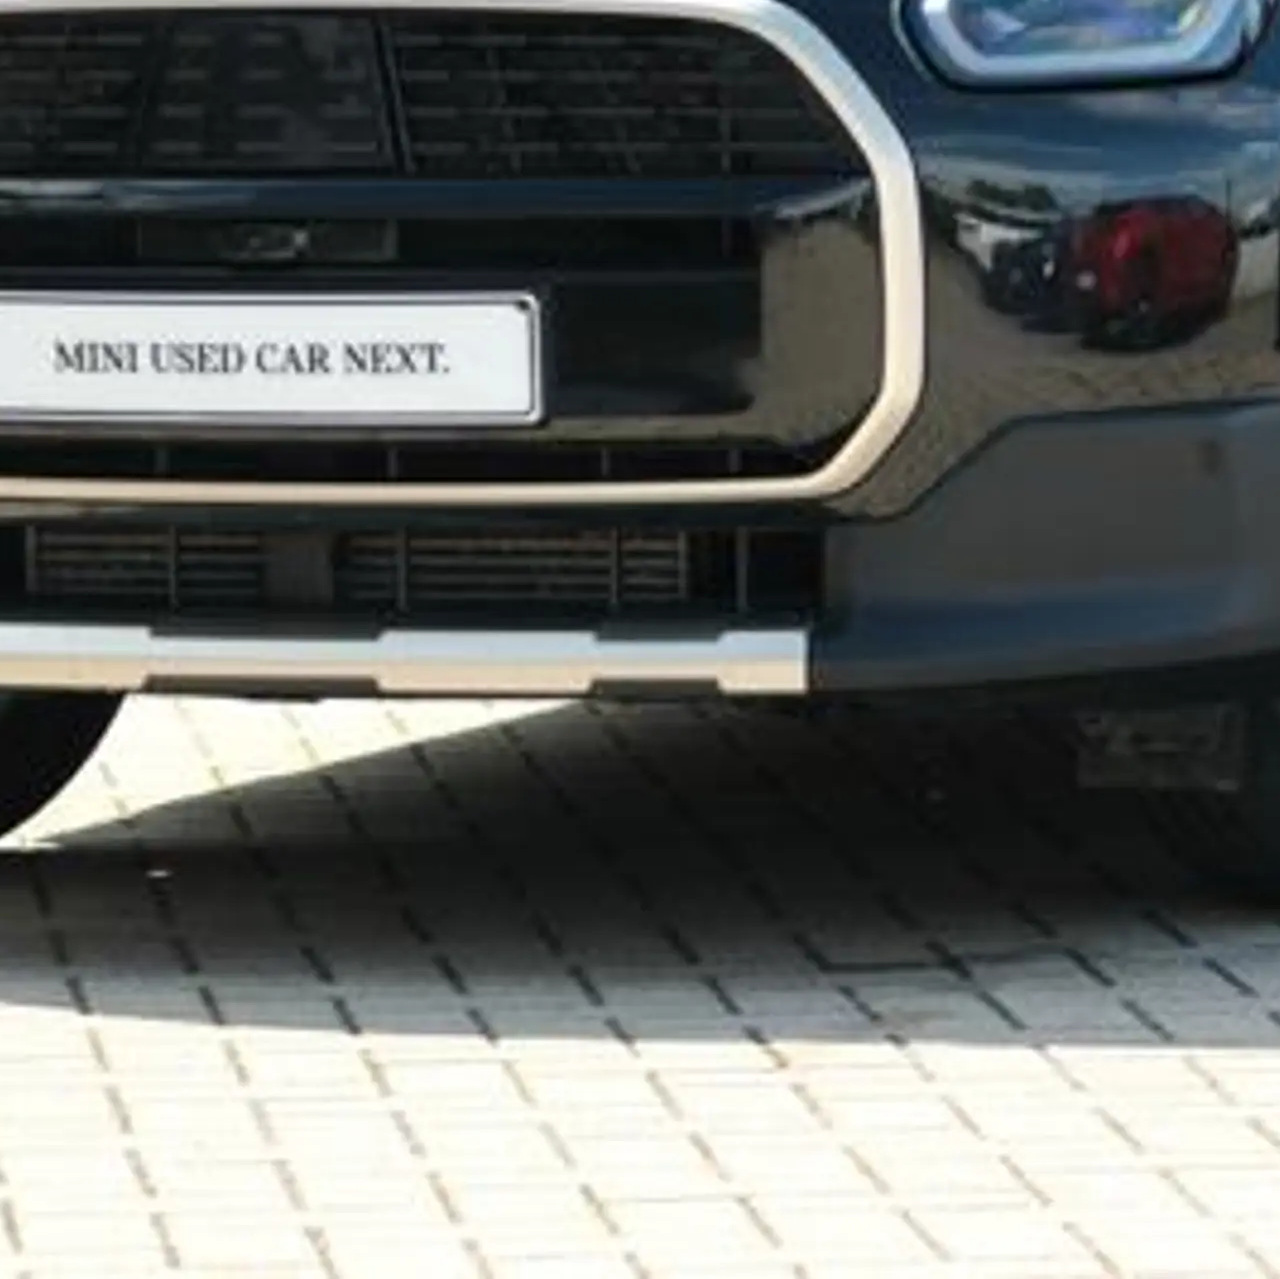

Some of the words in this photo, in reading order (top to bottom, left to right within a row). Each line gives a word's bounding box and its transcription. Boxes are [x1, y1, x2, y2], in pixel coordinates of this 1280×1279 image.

[54, 342, 139, 373] MINI
[150, 342, 246, 374] USED
[255, 343, 330, 374] CAR
[343, 342, 450, 374] NEXT.
